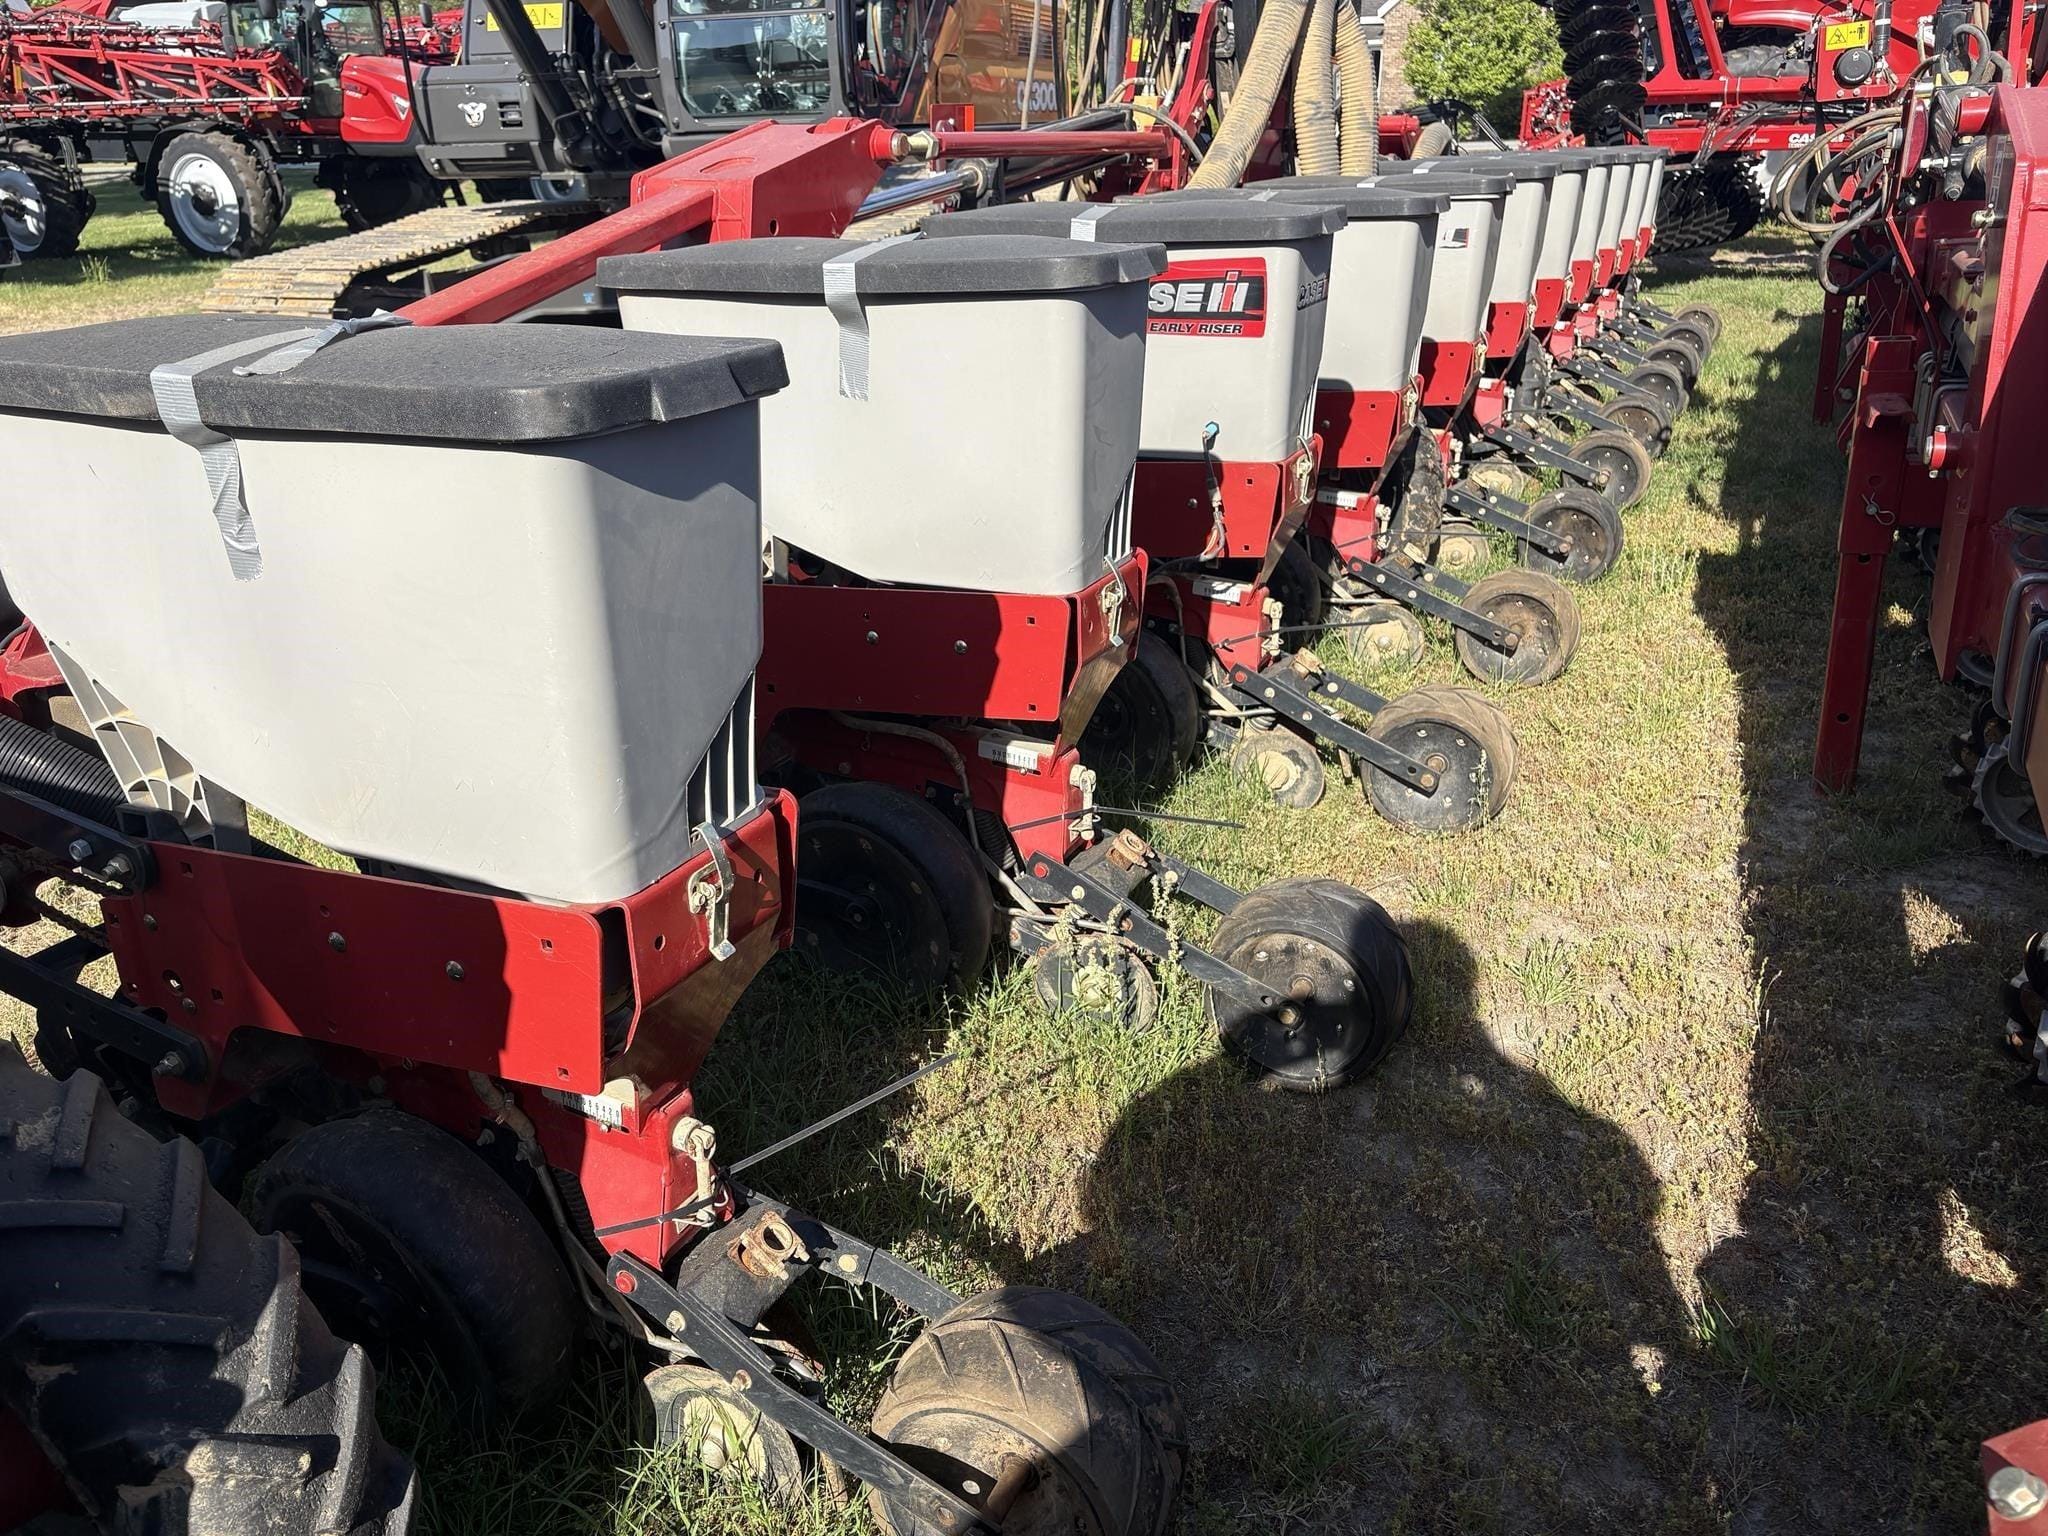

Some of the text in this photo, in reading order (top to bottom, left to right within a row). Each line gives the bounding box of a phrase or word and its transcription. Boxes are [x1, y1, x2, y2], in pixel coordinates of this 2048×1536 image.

[1148, 282, 1205, 313] SE
[1149, 321, 1243, 335] EARLY RISER
